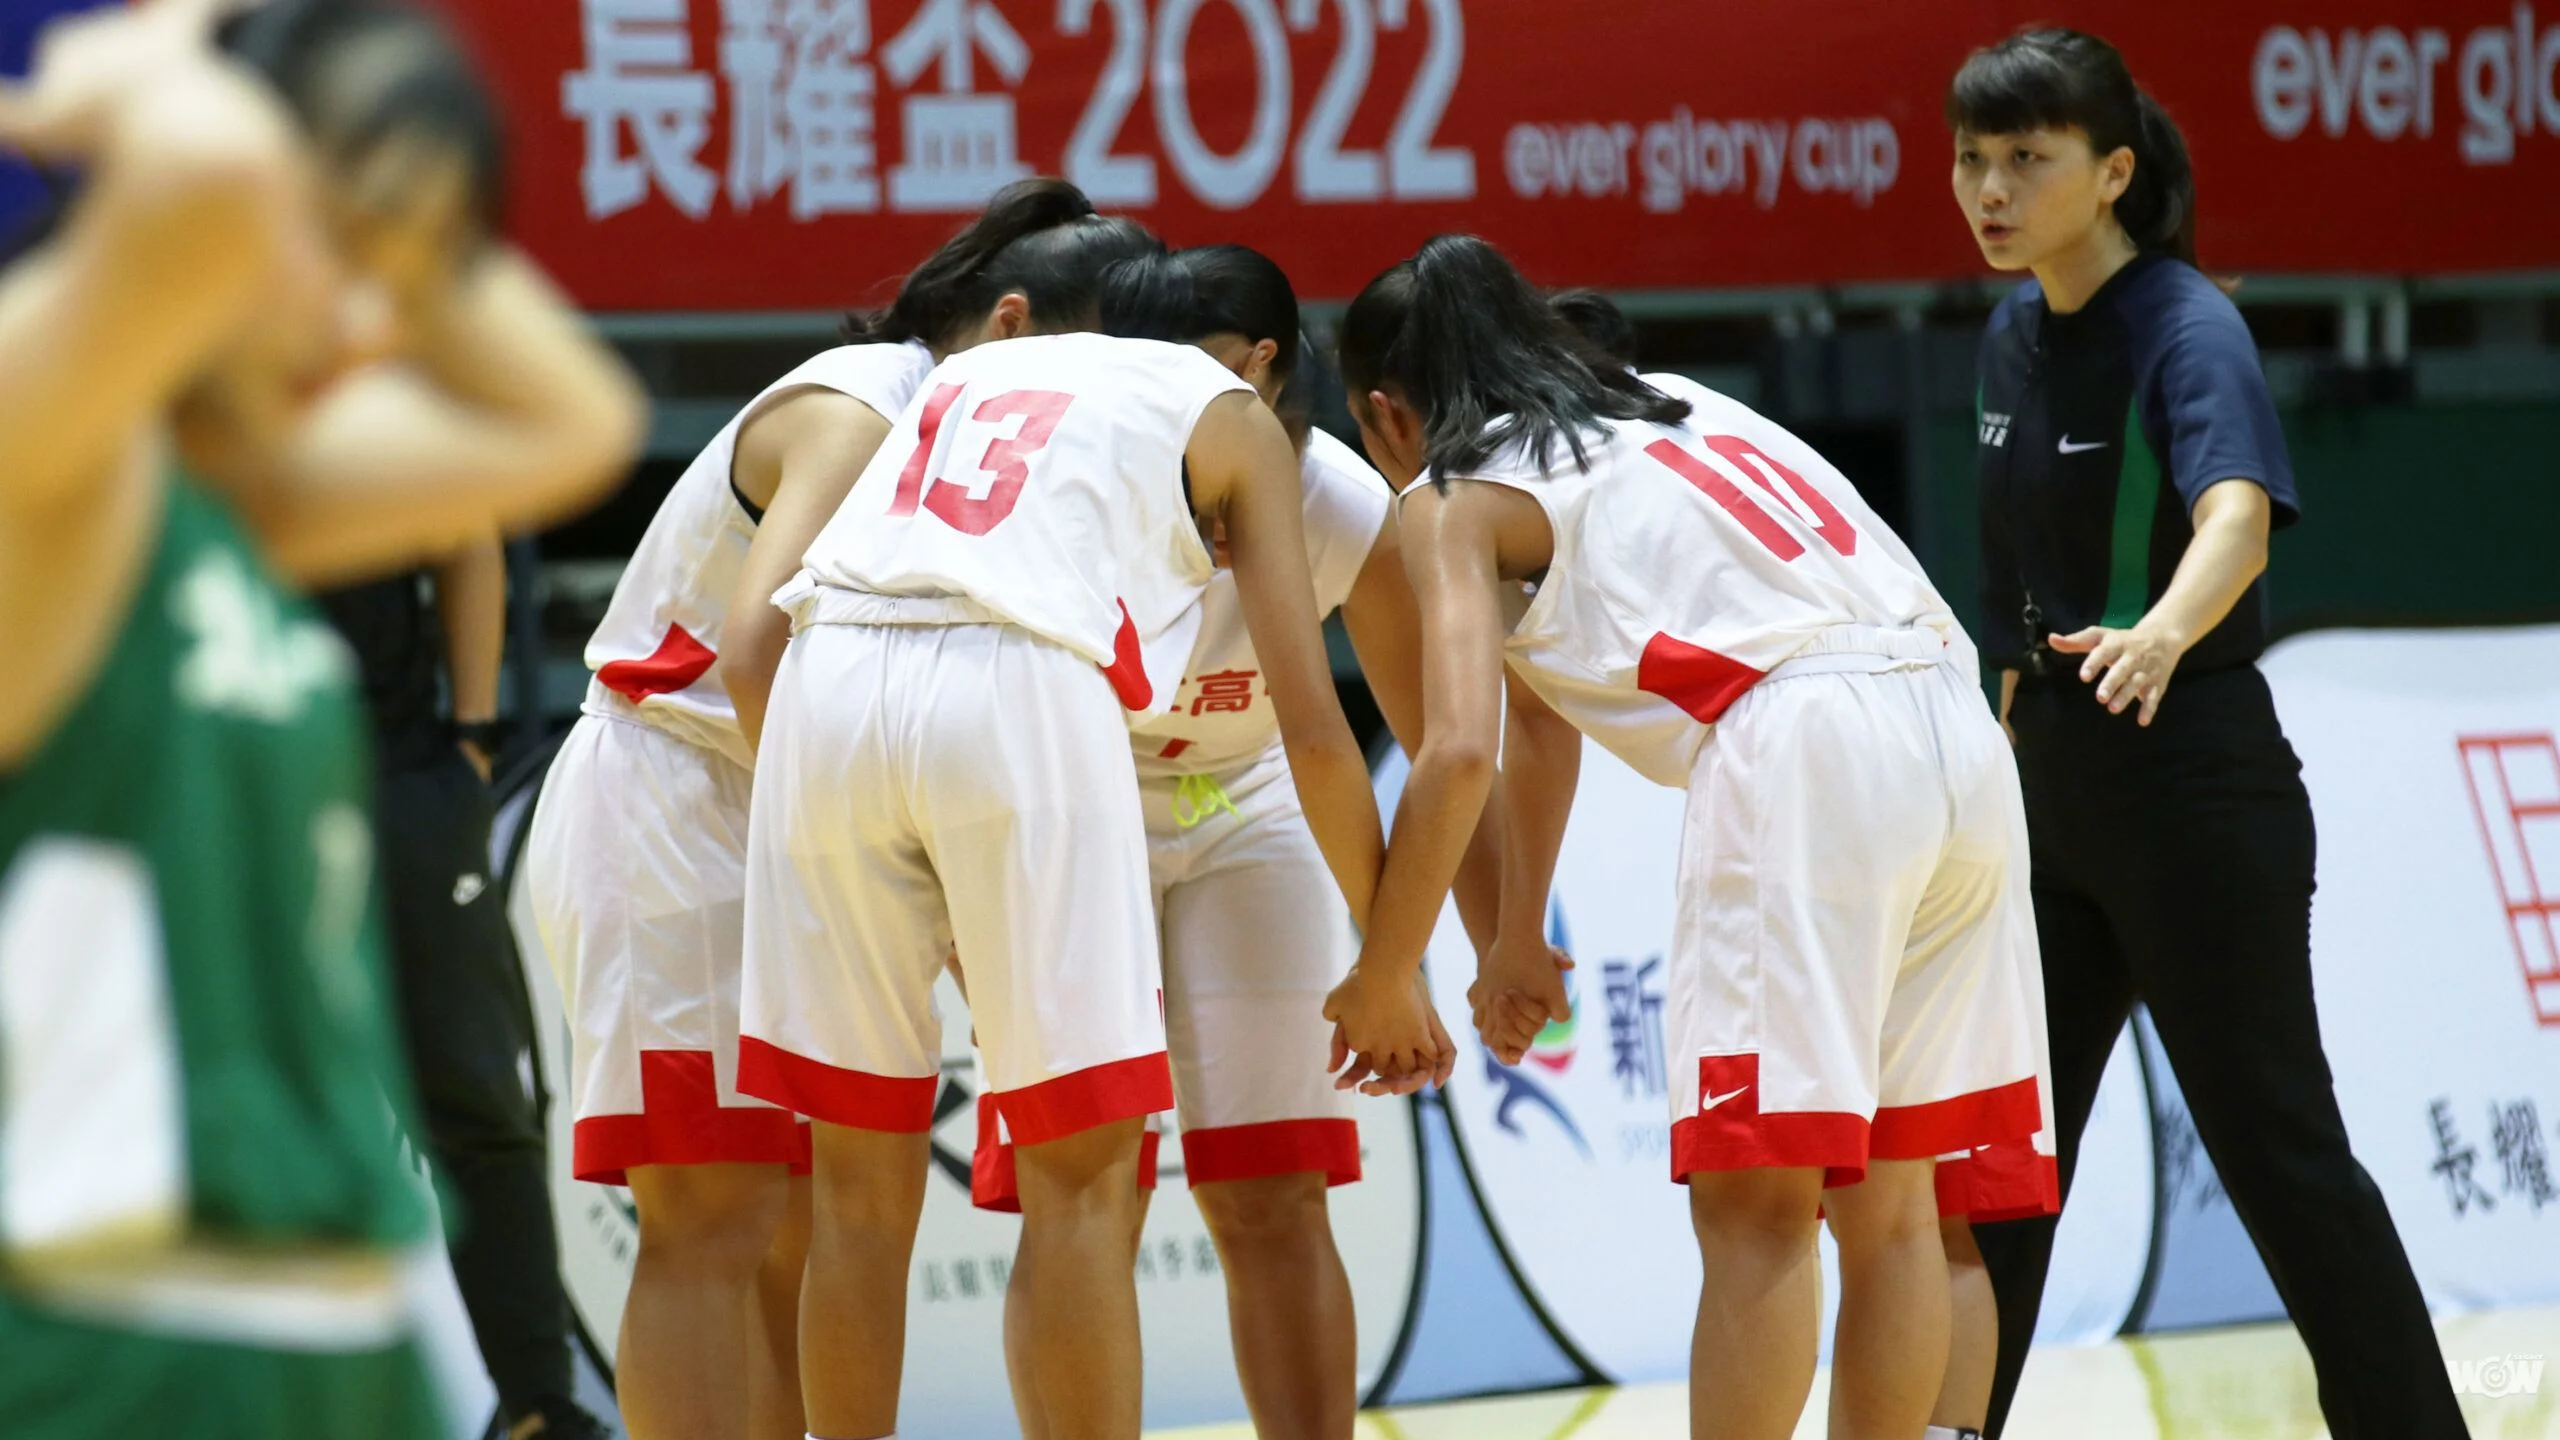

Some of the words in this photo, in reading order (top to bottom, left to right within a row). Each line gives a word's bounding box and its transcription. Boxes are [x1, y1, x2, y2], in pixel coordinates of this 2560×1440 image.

[2252, 24, 2450, 141] ever
[1505, 121, 1637, 199] ever
[1639, 104, 1791, 213] glory
[1791, 115, 1899, 209] cup
[883, 381, 1075, 537] 13
[1643, 434, 1857, 562] 10
[2427, 1098, 2560, 1218] 長耀
